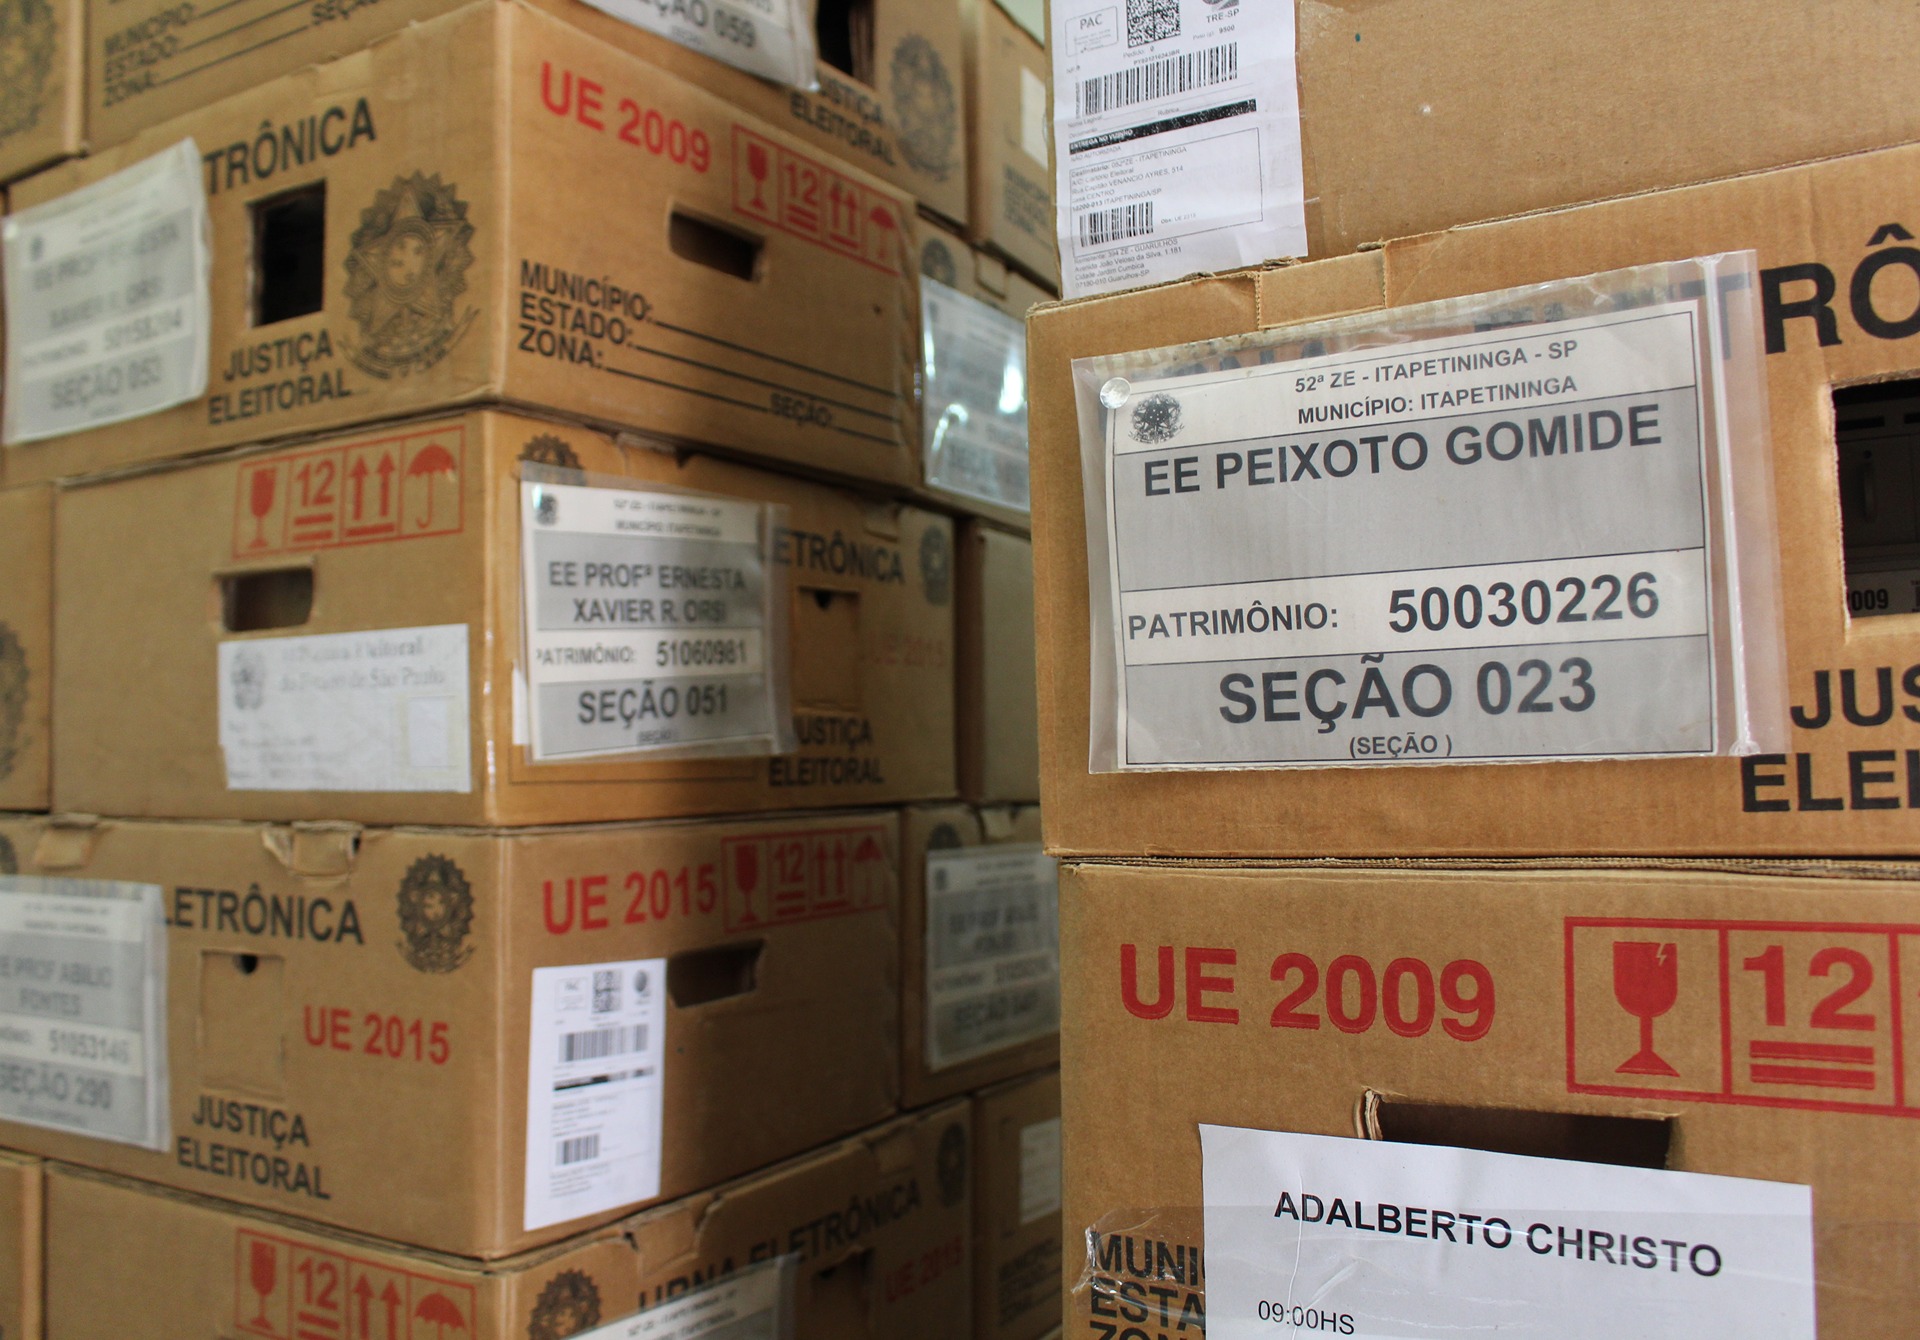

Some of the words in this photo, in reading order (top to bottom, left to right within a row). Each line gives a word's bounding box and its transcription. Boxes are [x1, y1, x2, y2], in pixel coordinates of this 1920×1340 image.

[1080, 14, 1103, 29] PAC
[1206, 8, 1240, 23] TRE-SP
[541, 61, 604, 131] UE
[618, 98, 711, 174] 2009
[1139, 146, 1187, 162] ITAPETININGA
[784, 160, 818, 206] 12
[1118, 262, 1145, 273] Cumbica
[1135, 238, 1179, 253] GUARULHOS
[1136, 253, 1145, 261] da
[520, 258, 652, 324] MUNICÍPIO:
[520, 292, 634, 347] ESTADO:
[223, 329, 334, 382] JUSTIÇA
[518, 324, 604, 369] ZONA:
[1295, 373, 1324, 393] 52ª
[1328, 369, 1356, 391] ZE
[1374, 347, 1527, 384] ITAPETININGA
[1548, 338, 1580, 364] SP
[208, 368, 352, 425] ELEITORAL
[1297, 395, 1413, 425] MUNICÍPIO:
[1420, 374, 1578, 409] ITAPETININGA
[1144, 455, 1200, 497] EE
[1216, 431, 1429, 490] PEIXOTO
[1444, 403, 1663, 466] GOMIDE
[297, 460, 335, 508] 12
[549, 561, 577, 587] EE
[584, 562, 652, 588] PROFª
[658, 565, 746, 590] ERNESTA
[573, 598, 656, 623] XAVIER
[661, 600, 678, 623] R.
[683, 599, 729, 623] ORSI
[1127, 599, 1339, 641] PATRIMÔNIO:
[1388, 570, 1661, 634] 50030226
[656, 640, 747, 667] 51060981
[577, 679, 680, 730] SEÇÃO
[686, 684, 728, 716] 051
[1218, 653, 1453, 735] SEÇÃO
[1476, 656, 1598, 716] 023
[1348, 733, 1439, 759] (SEÇÃO
[768, 757, 884, 787] ELEITORAL
[775, 843, 804, 882] 12
[163, 883, 365, 945] ETRÔNICA
[543, 874, 609, 935] UE
[623, 863, 717, 925] 2015
[1120, 943, 1239, 1025] UE
[1270, 952, 1496, 1042] 2009
[1742, 946, 1875, 1031] 12
[303, 1004, 352, 1051] UE
[363, 1013, 451, 1065] 2015
[192, 1093, 310, 1151] JUSTIÇA
[176, 1135, 331, 1201] ELEITORAL
[1090, 1230, 1205, 1287] MUNI
[1273, 1191, 1513, 1250] ADALBERTO
[1525, 1222, 1723, 1278] CHRISTO
[298, 1261, 339, 1311] 12
[1257, 1299, 1356, 1336] 09:00HS
